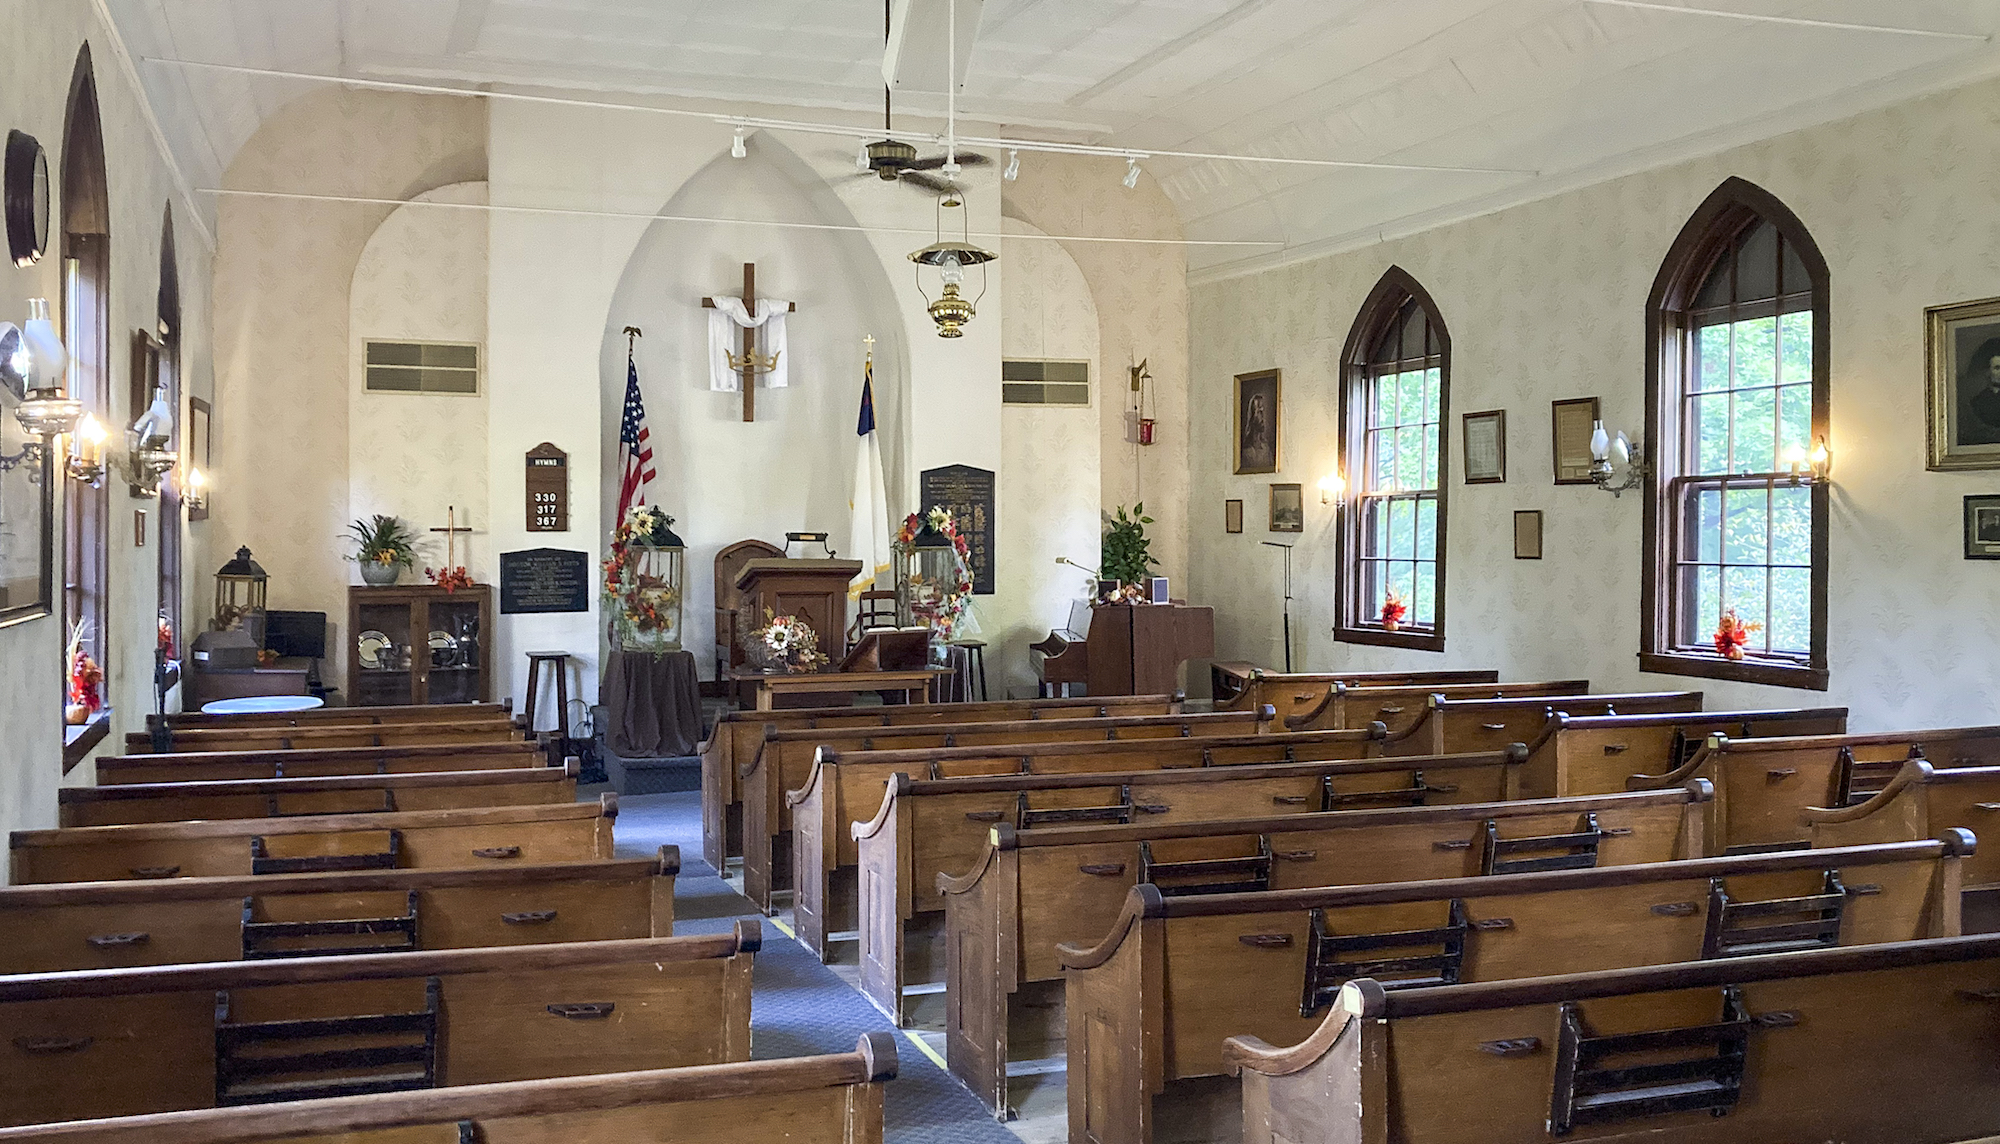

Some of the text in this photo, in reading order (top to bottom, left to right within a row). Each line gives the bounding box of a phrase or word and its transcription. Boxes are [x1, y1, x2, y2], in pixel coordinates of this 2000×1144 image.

[535, 493, 556, 502] 330
[537, 505, 556, 514] 317
[536, 517, 557, 526] 367
